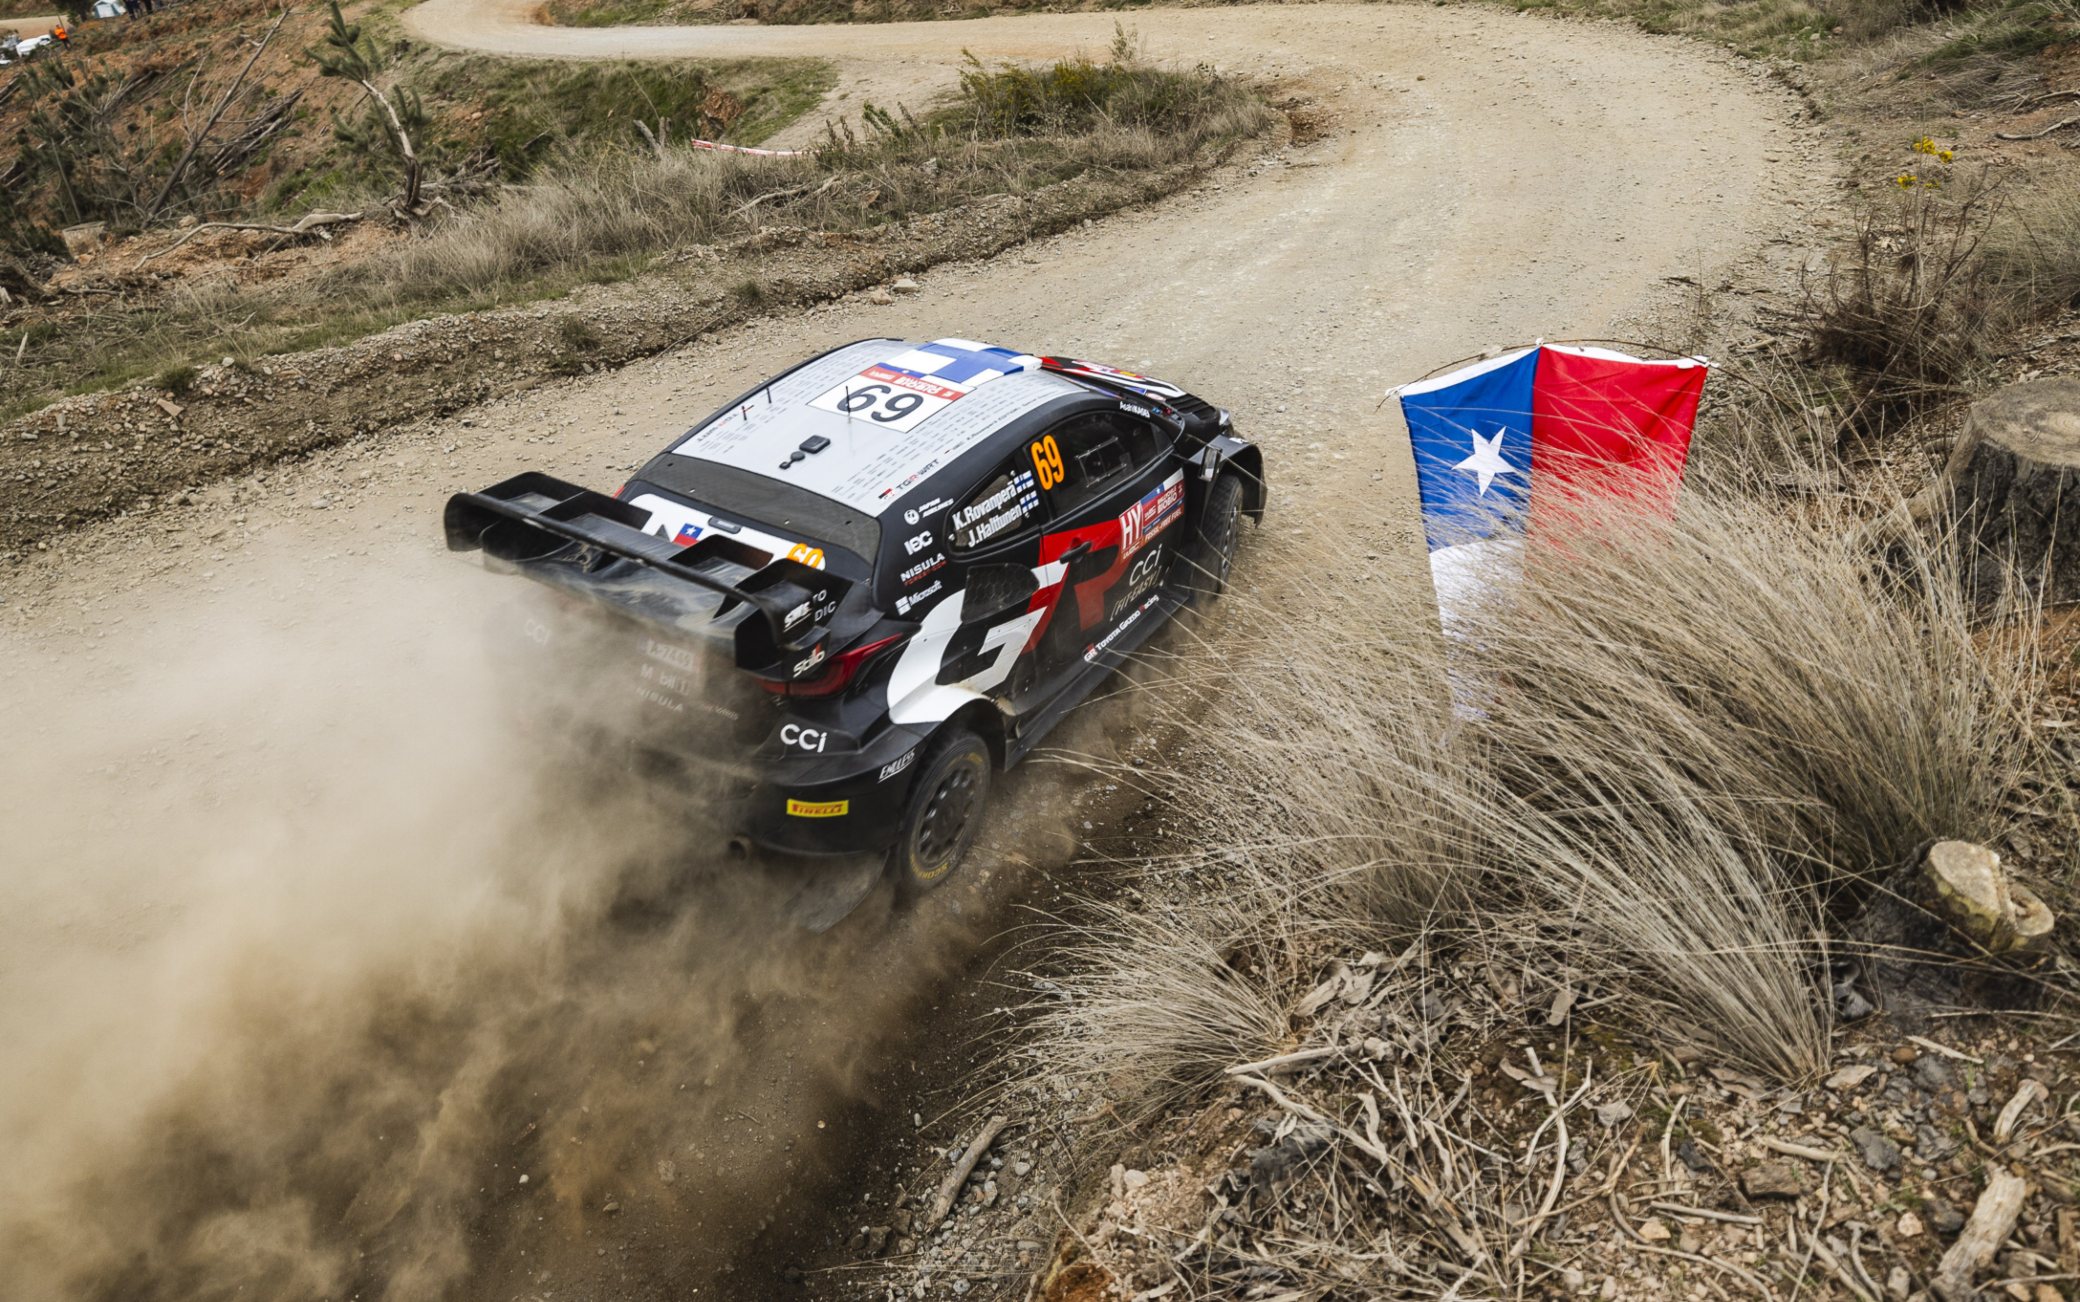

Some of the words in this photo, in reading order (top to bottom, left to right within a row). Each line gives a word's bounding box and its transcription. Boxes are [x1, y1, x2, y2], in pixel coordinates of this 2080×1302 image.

[837, 384, 924, 423] 69
[1030, 434, 1065, 490] 69
[1120, 503, 1143, 550] HY
[900, 552, 946, 582] NISULA
[908, 579, 943, 607] Microsoft
[791, 803, 843, 815] PIRELLI
